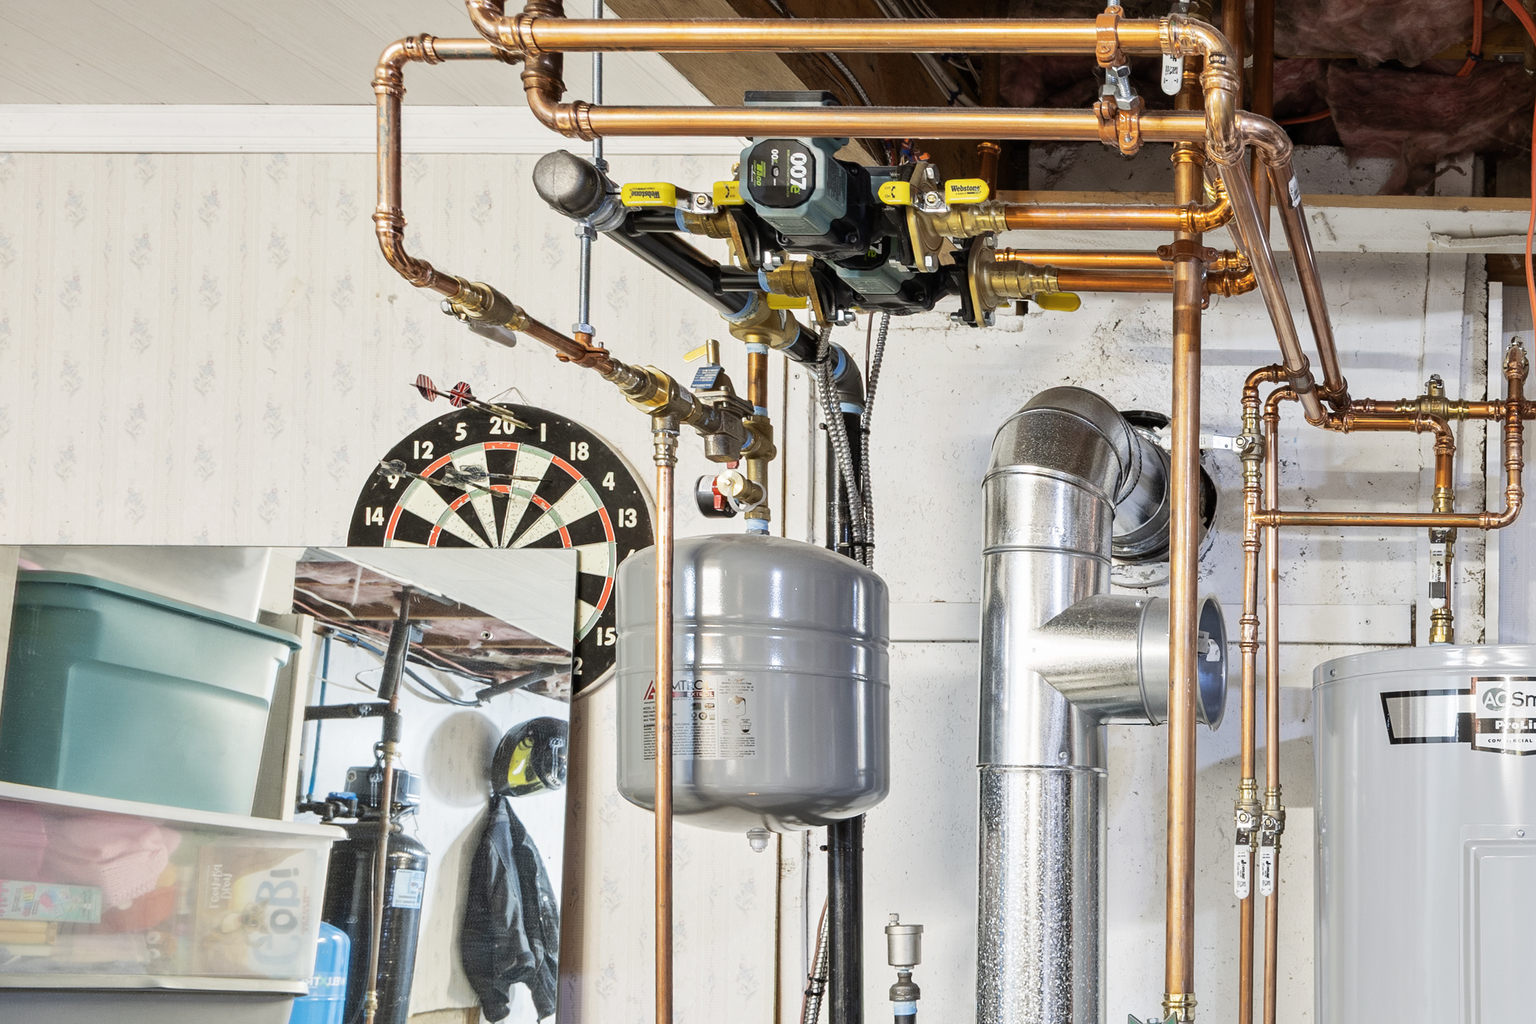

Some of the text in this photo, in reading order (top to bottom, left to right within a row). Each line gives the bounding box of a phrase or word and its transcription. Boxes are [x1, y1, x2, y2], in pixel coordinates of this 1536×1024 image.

[790, 152, 807, 194] 007e
[455, 422, 468, 442] 5
[489, 417, 516, 435] 20
[540, 423, 547, 442] 1
[413, 441, 434, 460] 12
[570, 442, 590, 461] 18
[602, 472, 615, 490] 4
[365, 507, 385, 526] 14
[618, 508, 638, 528] 13
[597, 627, 616, 646] 15
